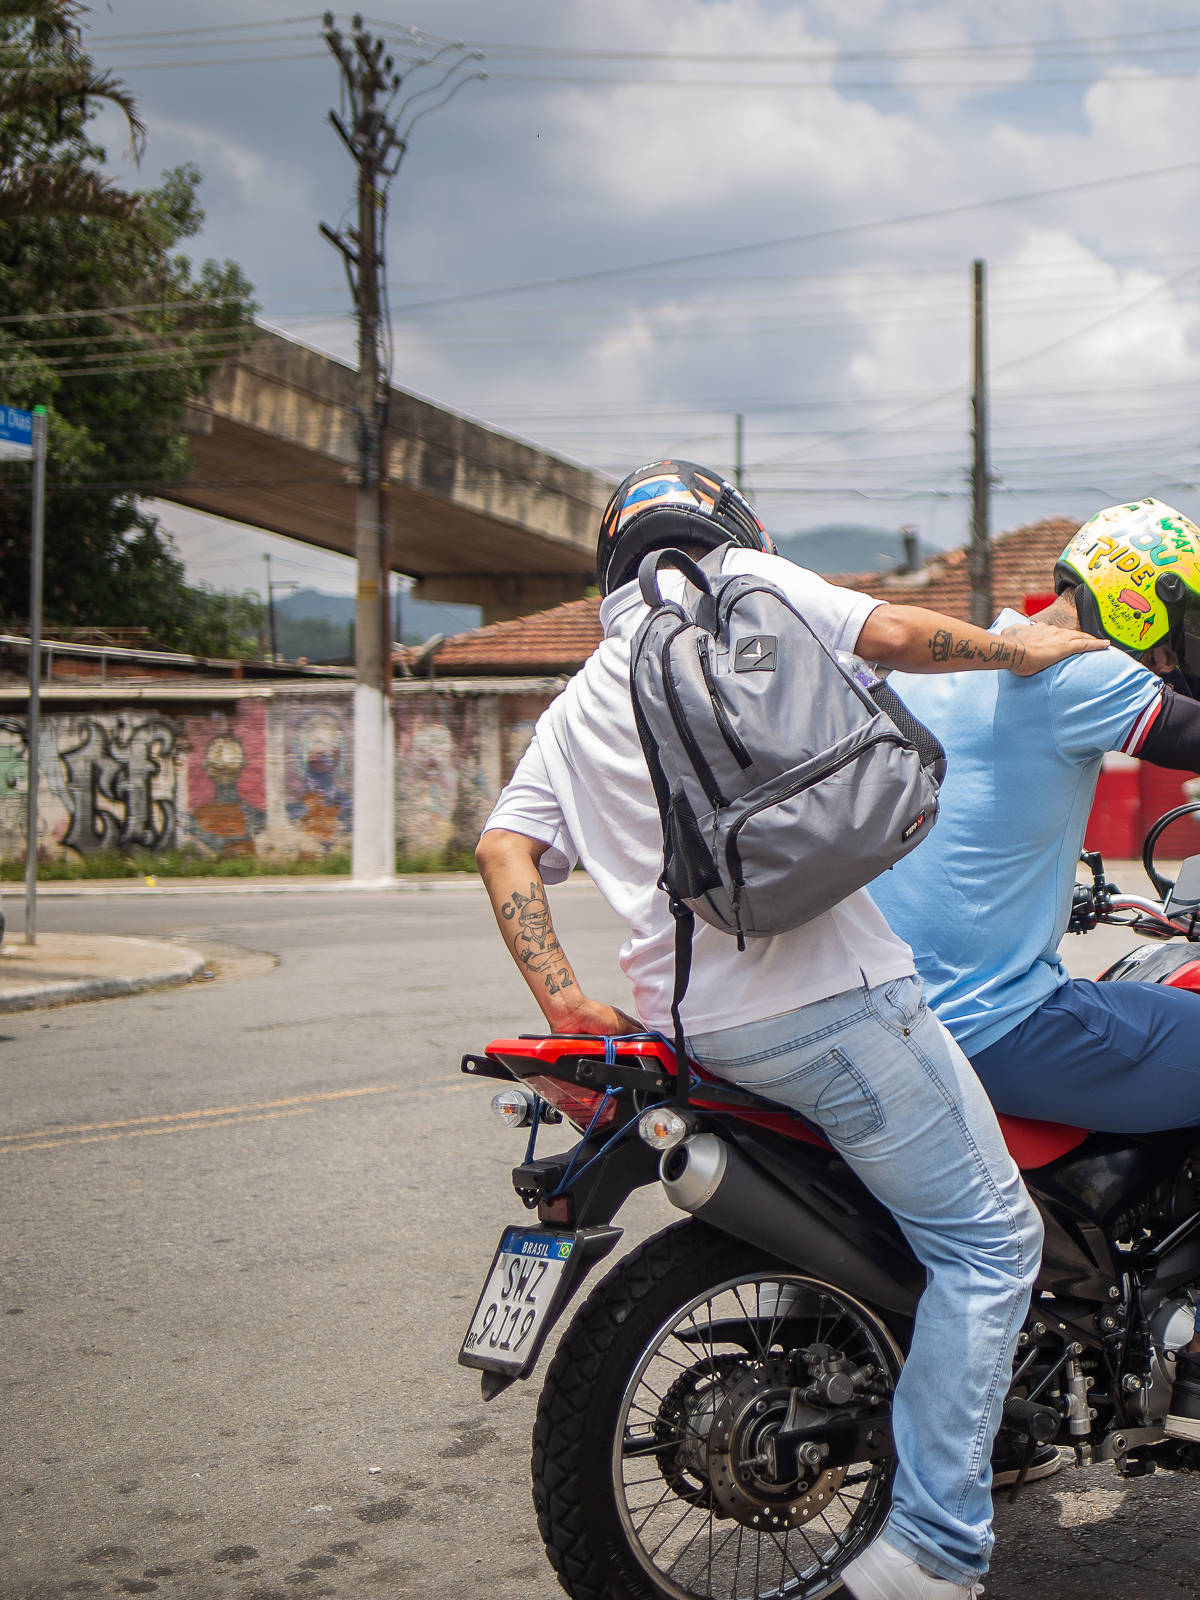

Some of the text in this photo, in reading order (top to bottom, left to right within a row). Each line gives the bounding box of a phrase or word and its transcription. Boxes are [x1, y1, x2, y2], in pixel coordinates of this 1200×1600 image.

[1085, 535, 1155, 586] RIDE
[545, 968, 573, 995] 12
[521, 1242, 549, 1257] BRASIL
[501, 1258, 549, 1304] SWZ
[466, 1332, 478, 1350] BR
[477, 1303, 536, 1353] 9J19
